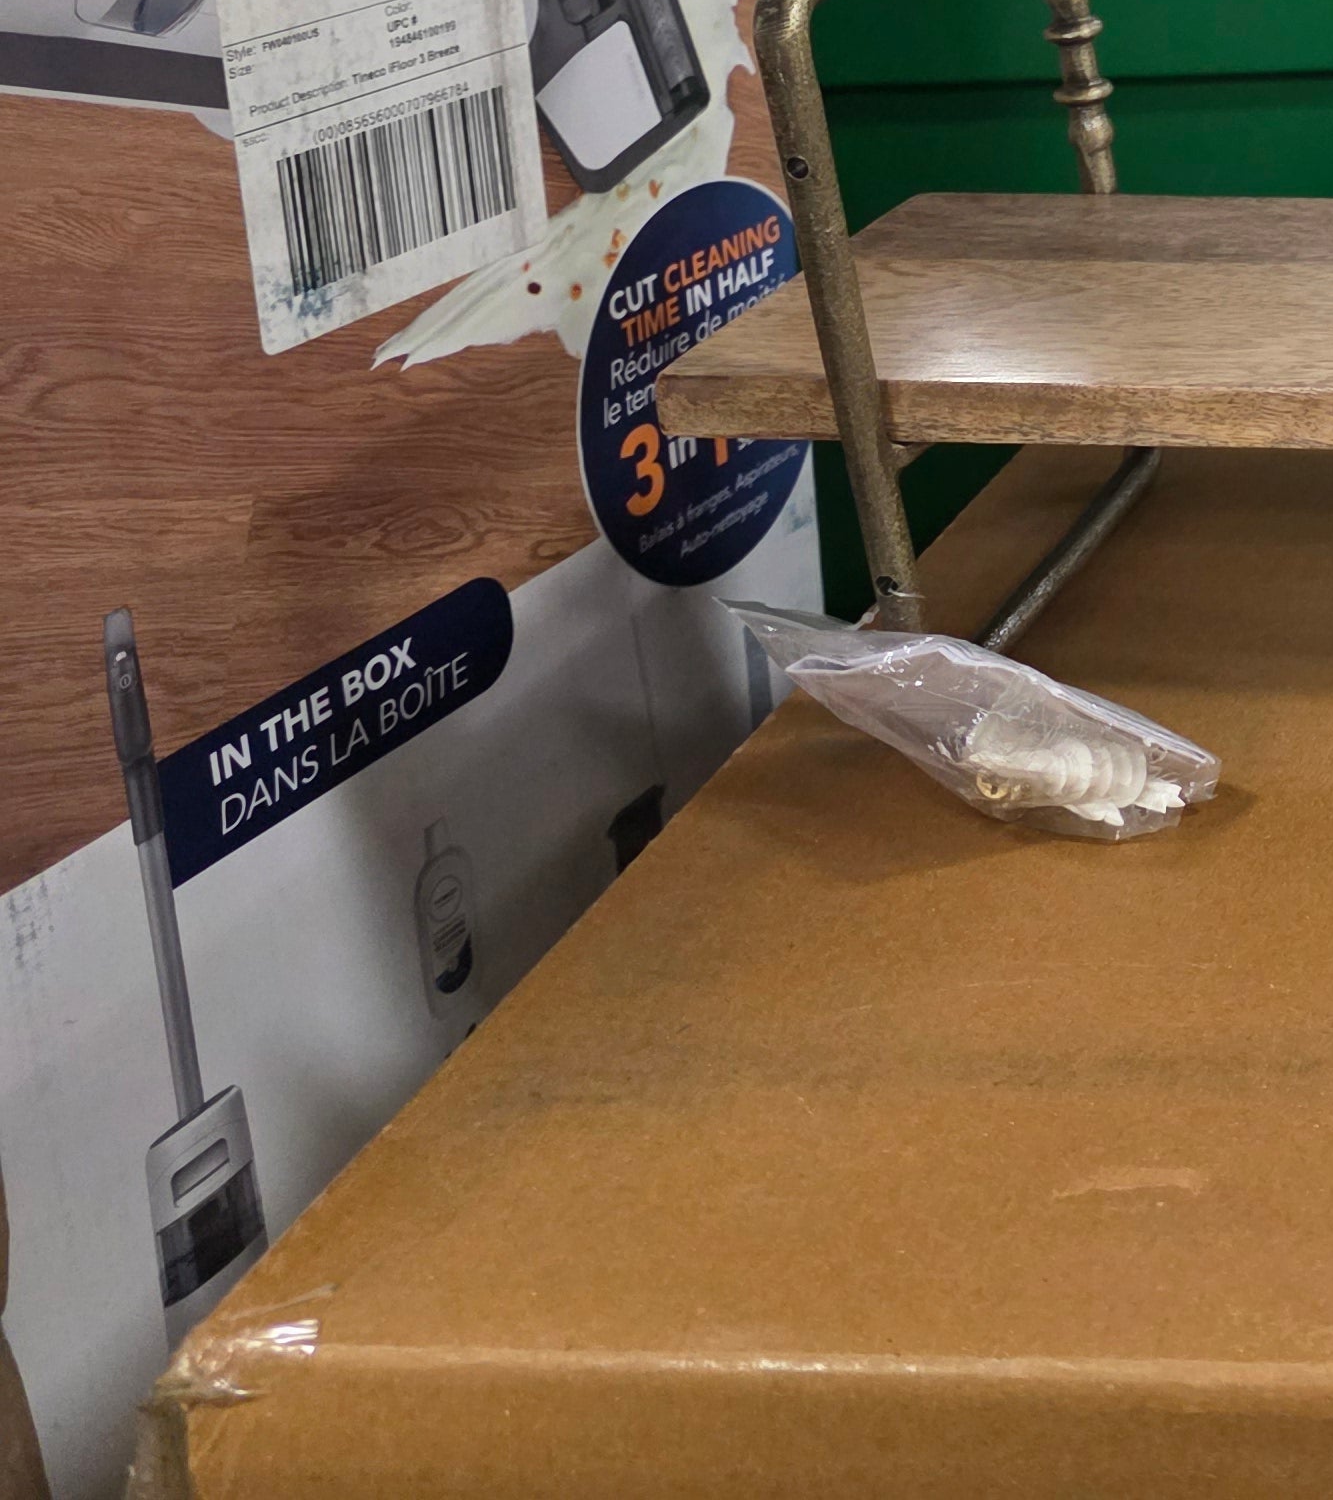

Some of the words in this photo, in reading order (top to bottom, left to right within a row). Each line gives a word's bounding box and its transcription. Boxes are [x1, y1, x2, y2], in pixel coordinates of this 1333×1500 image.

[226, 46, 257, 64] Style:
[387, 17, 409, 33] UPC
[249, 96, 291, 118] Product
[351, 67, 387, 86] Tineco
[609, 273, 658, 320] CUT
[663, 215, 781, 293] CLEANING
[621, 297, 682, 347] TIME
[686, 279, 713, 316] IN
[717, 248, 775, 300] HALF
[610, 333, 690, 390] Réduire
[695, 310, 722, 342] de
[603, 397, 621, 429] le
[620, 423, 665, 517] 3
[667, 435, 698, 471] in
[209, 733, 252, 787] IN
[260, 686, 333, 751] THE
[341, 637, 416, 707] BOX
[221, 745, 319, 835] DANS
[330, 718, 370, 766] LA
[379, 652, 469, 736] BOÎTE
